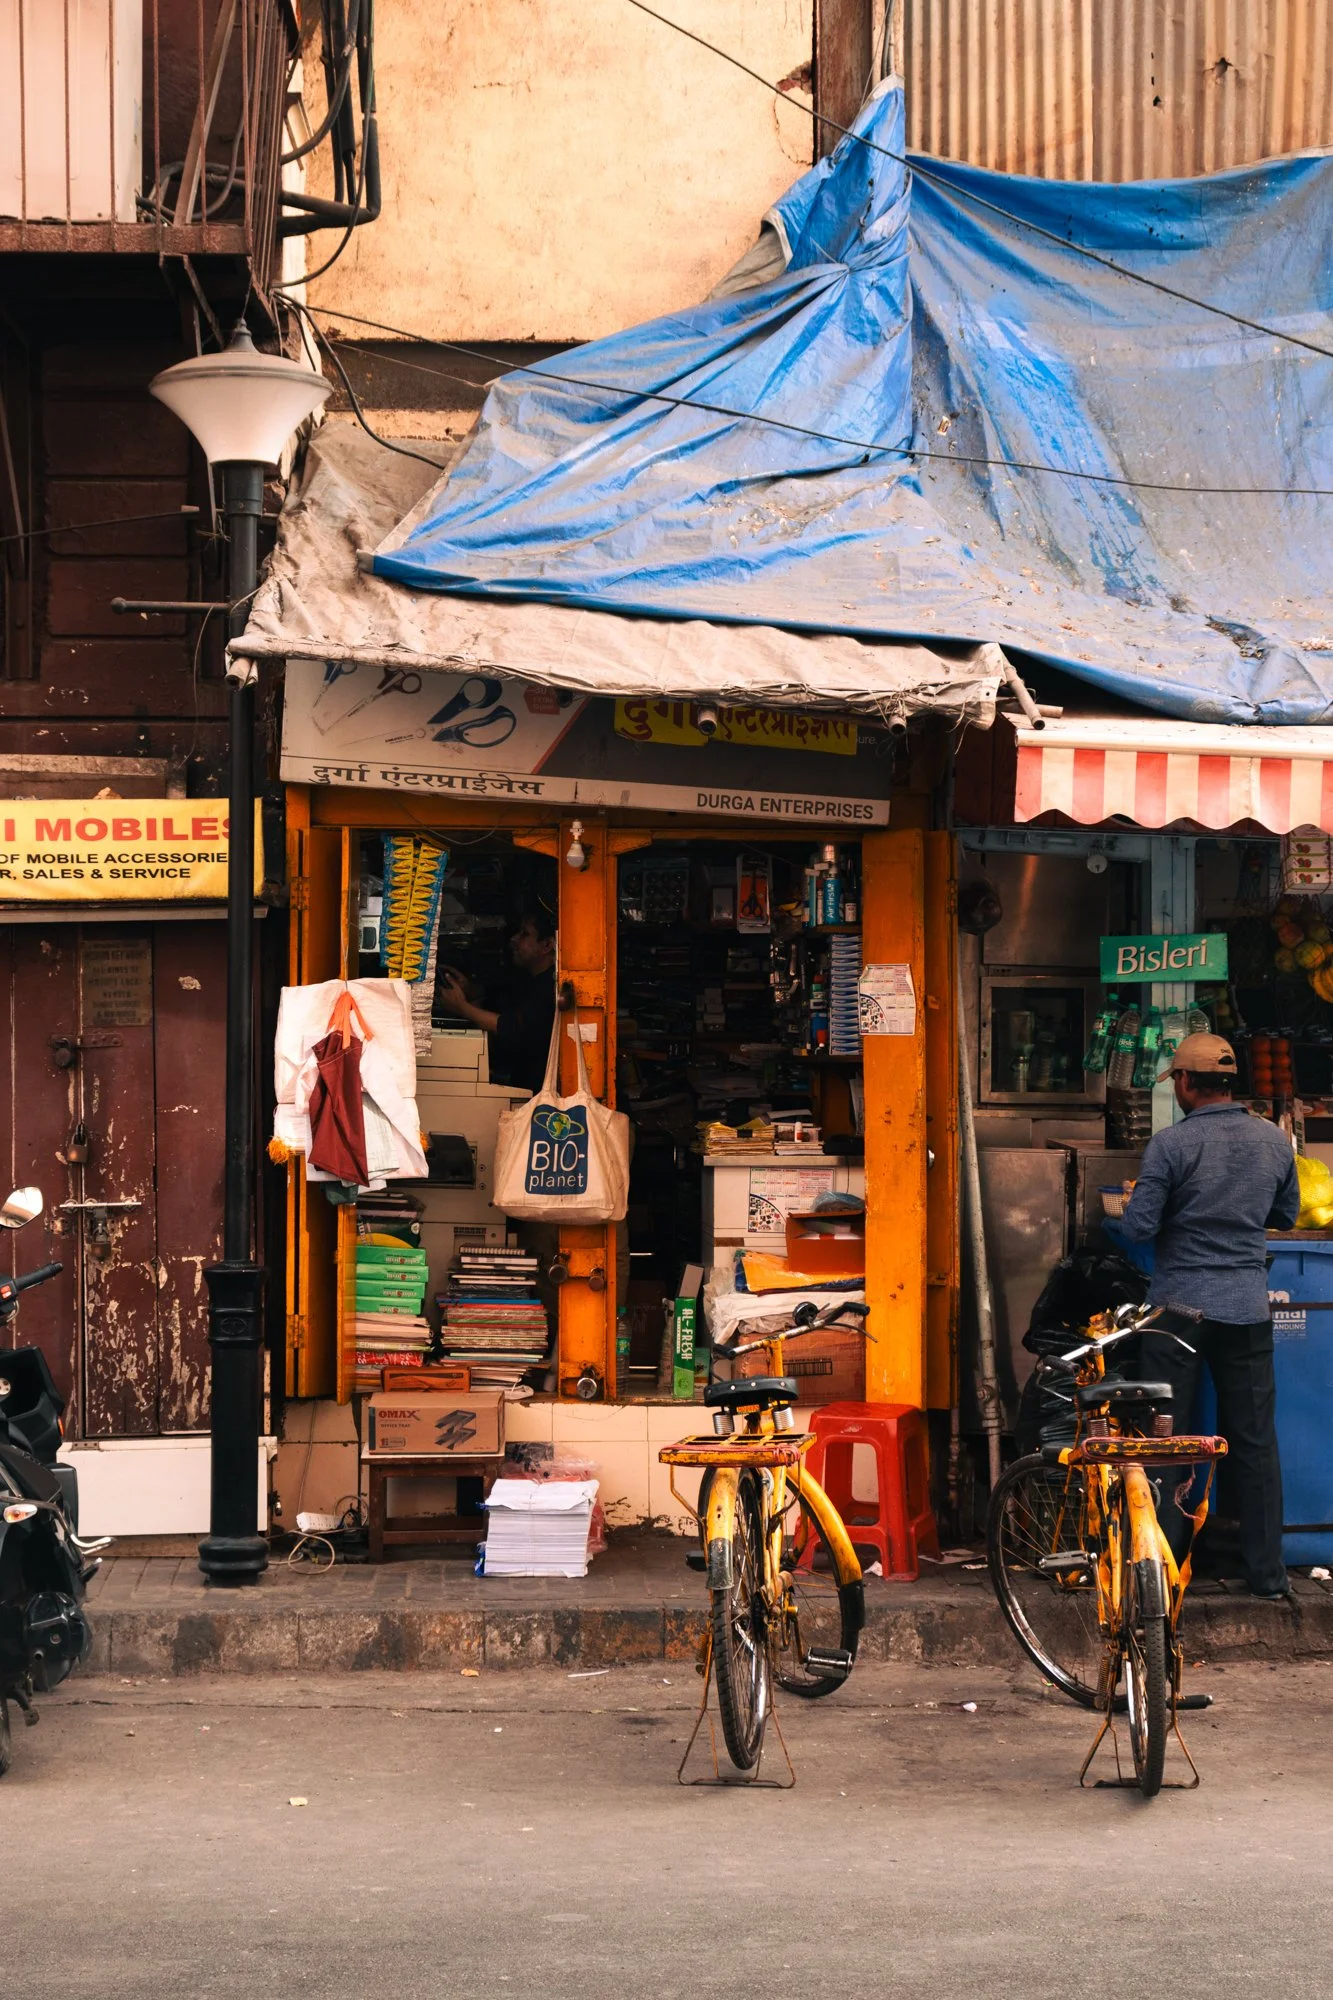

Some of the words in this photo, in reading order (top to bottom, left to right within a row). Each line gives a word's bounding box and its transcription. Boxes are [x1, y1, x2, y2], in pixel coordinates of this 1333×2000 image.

[308, 764, 371, 784] दुर्गा
[697, 793, 755, 812] DURGA
[760, 797, 874, 820] ENTERPRISES
[35, 817, 229, 842] MOBILE
[26, 853, 98, 864] MOBILE
[103, 853, 229, 864] ACCESSORIE
[22, 869, 84, 879] SALES
[90, 869, 103, 879] &
[109, 868, 191, 879] SERVICE
[1116, 938, 1207, 975] Bisleri
[531, 1140, 585, 1172] BIO-
[529, 1171, 584, 1192] planet
[378, 1410, 420, 1421] OMAX
